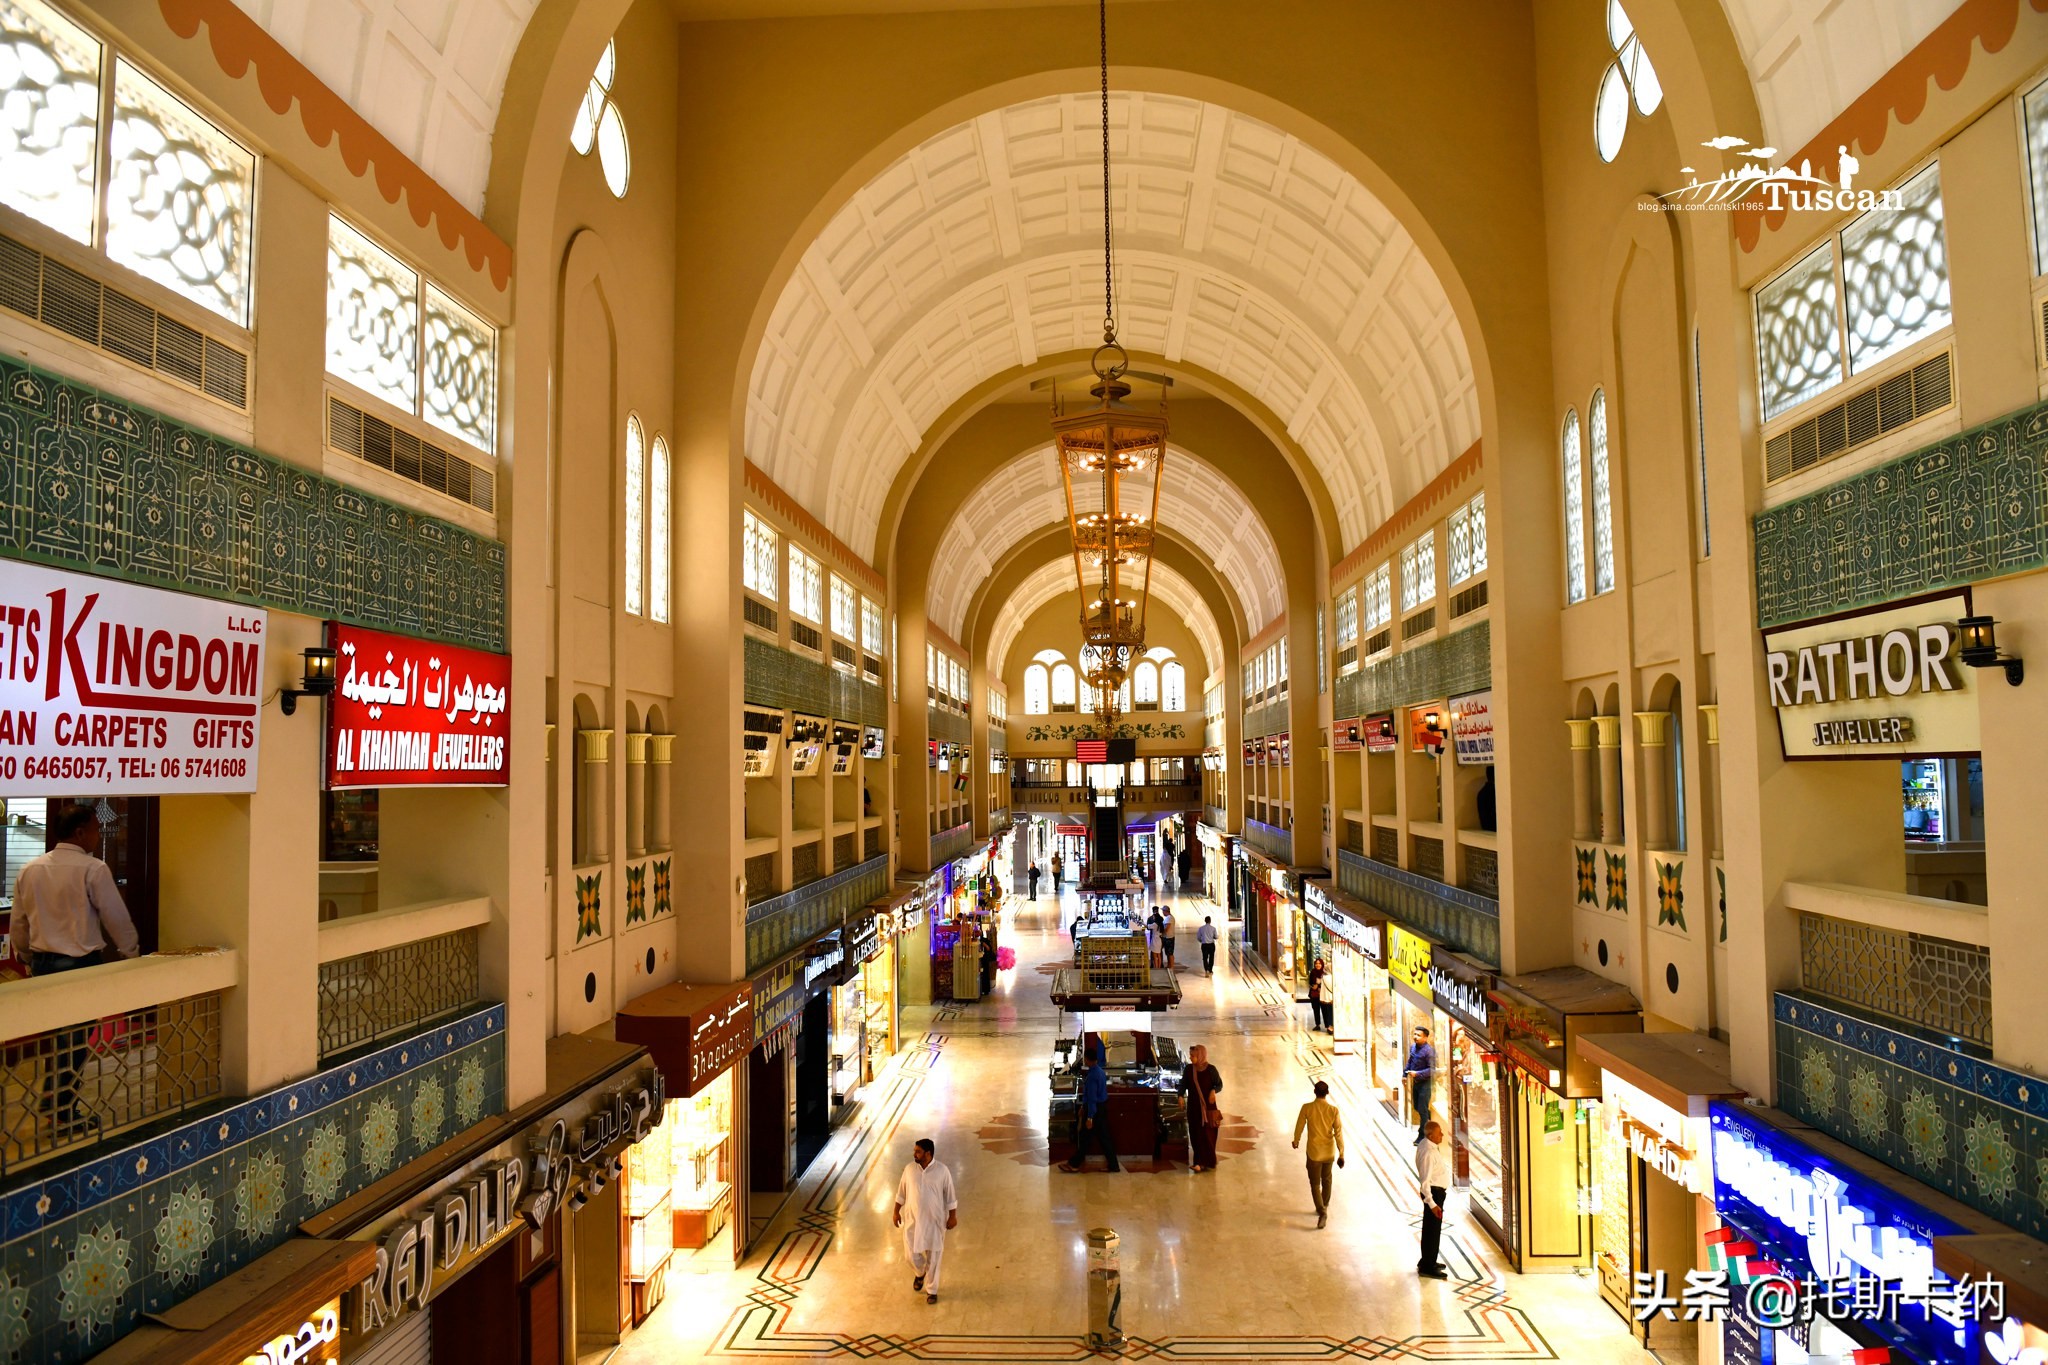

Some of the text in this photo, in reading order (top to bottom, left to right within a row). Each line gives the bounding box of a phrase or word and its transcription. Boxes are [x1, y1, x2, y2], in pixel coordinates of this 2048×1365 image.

[228, 616, 262, 634] L.L.C
[45, 588, 259, 710] KINGDOM
[1766, 624, 1953, 707] RATHOR
[341, 640, 506, 727] مجوهرات الخيمة
[54, 712, 168, 749] CARPETS
[193, 718, 254, 749] GIFTS
[336, 729, 504, 771] AL KHAIMAH JEWELLERS
[1812, 717, 1904, 746] JEWELLER
[24, 756, 112, 783] 6465057,
[118, 757, 156, 778] TEL:
[161, 758, 180, 778] 06
[185, 758, 246, 778] 5741608
[1724, 1116, 1755, 1143] JEWELLERY
[362, 1158, 523, 1333] RAJ DILIP
